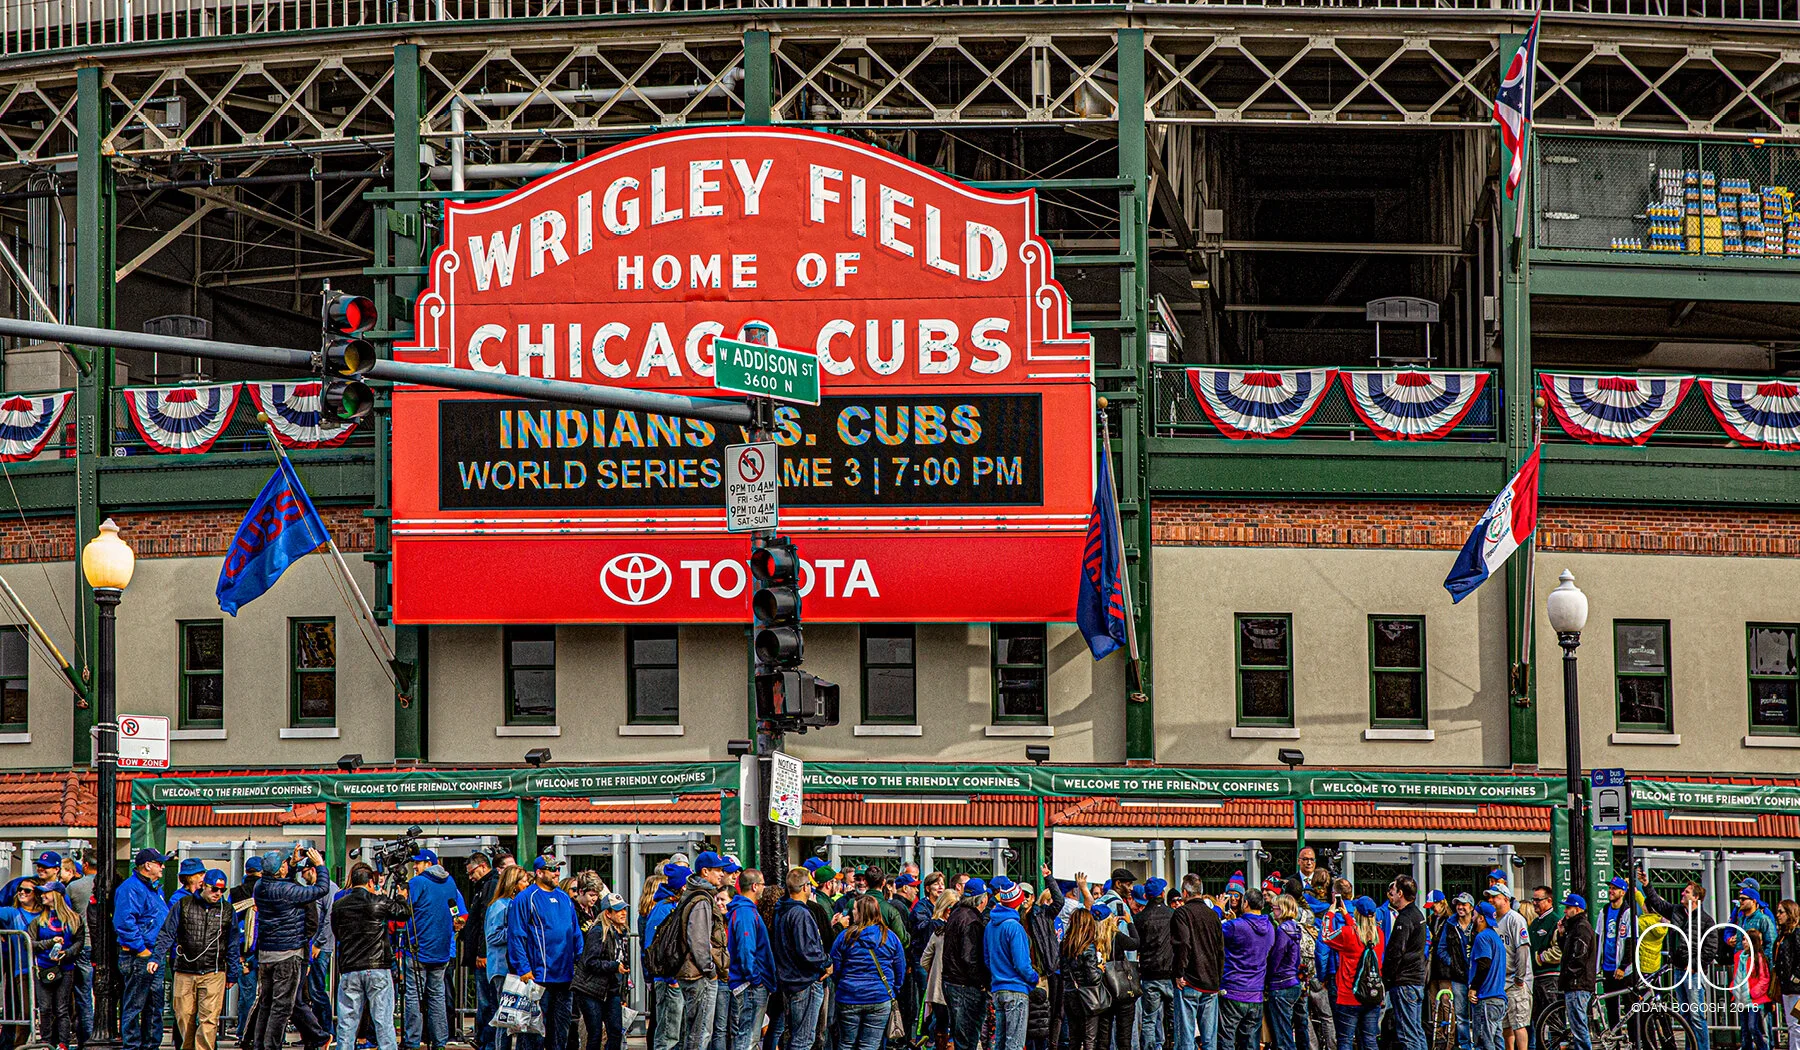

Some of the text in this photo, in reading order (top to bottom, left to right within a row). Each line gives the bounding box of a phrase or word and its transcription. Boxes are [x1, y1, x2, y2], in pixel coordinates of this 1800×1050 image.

[468, 159, 1008, 291] WRIGLEY FIELD
[618, 252, 860, 290] HOME OF
[467, 317, 1012, 378] CHICAG CUBS
[733, 348, 798, 376] ADDISON
[802, 363, 813, 376] ST
[744, 372, 792, 392] 3600 N
[500, 404, 982, 448] INDIANS S. CUBS
[458, 460, 587, 490] WORLD
[597, 458, 722, 489] SERIES
[777, 457, 833, 487] ME
[844, 457, 862, 486] 3
[892, 456, 960, 487] 7:00
[972, 456, 1022, 486] PM
[730, 480, 774, 496] 9PM TO 4AM
[730, 502, 774, 518] 9PM TO 4AM
[226, 489, 305, 578] CUBS
[680, 558, 880, 599] TOTA
[120, 758, 164, 767] TOW ZONE
[778, 758, 798, 771] NOTICE
[343, 781, 502, 794] WELCOME TO THE FRIENDLY CONFINES
[535, 772, 706, 788] WELCOME TO THE FRIENDLY CONFINES
[802, 774, 1020, 787] WELCOME TO THE FRIENDLY CONFINES
[1064, 778, 1279, 792] WELCOME TO THE FRIENDLY CONFINES
[162, 785, 312, 797] WELCOME TO THE FRIENDLY CONFINES
[1322, 782, 1536, 796] WELCOME TO THE FRIENDLY CONFINES
[1678, 792, 1692, 802] TO
[1694, 793, 1714, 803] THE
[1716, 794, 1762, 805] FRIENDLY
